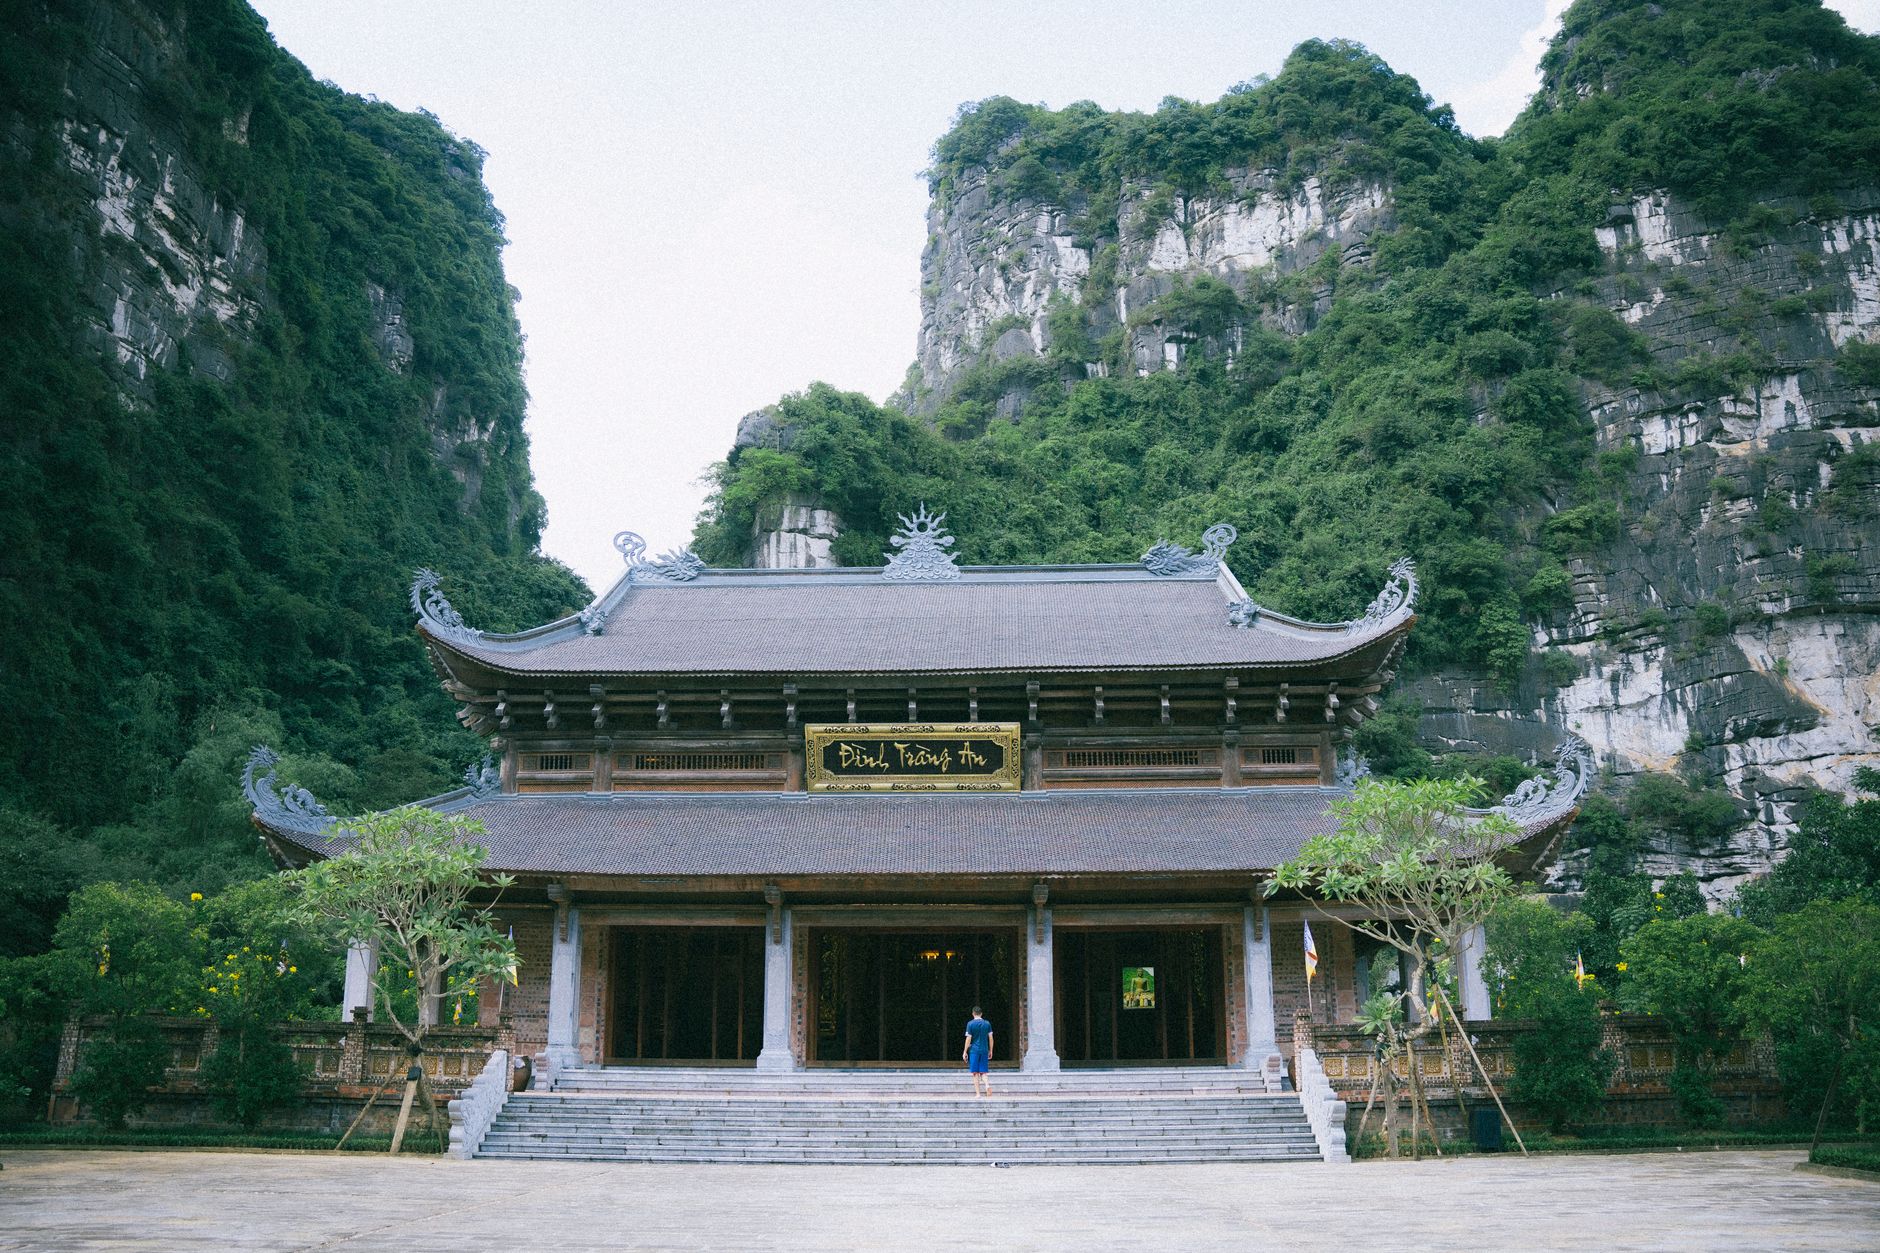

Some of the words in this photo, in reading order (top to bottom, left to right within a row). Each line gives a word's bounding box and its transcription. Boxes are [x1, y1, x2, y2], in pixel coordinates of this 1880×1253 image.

[839, 742, 889, 773] Đình
[894, 741, 952, 773] Tràng
[958, 741, 988, 770] An
